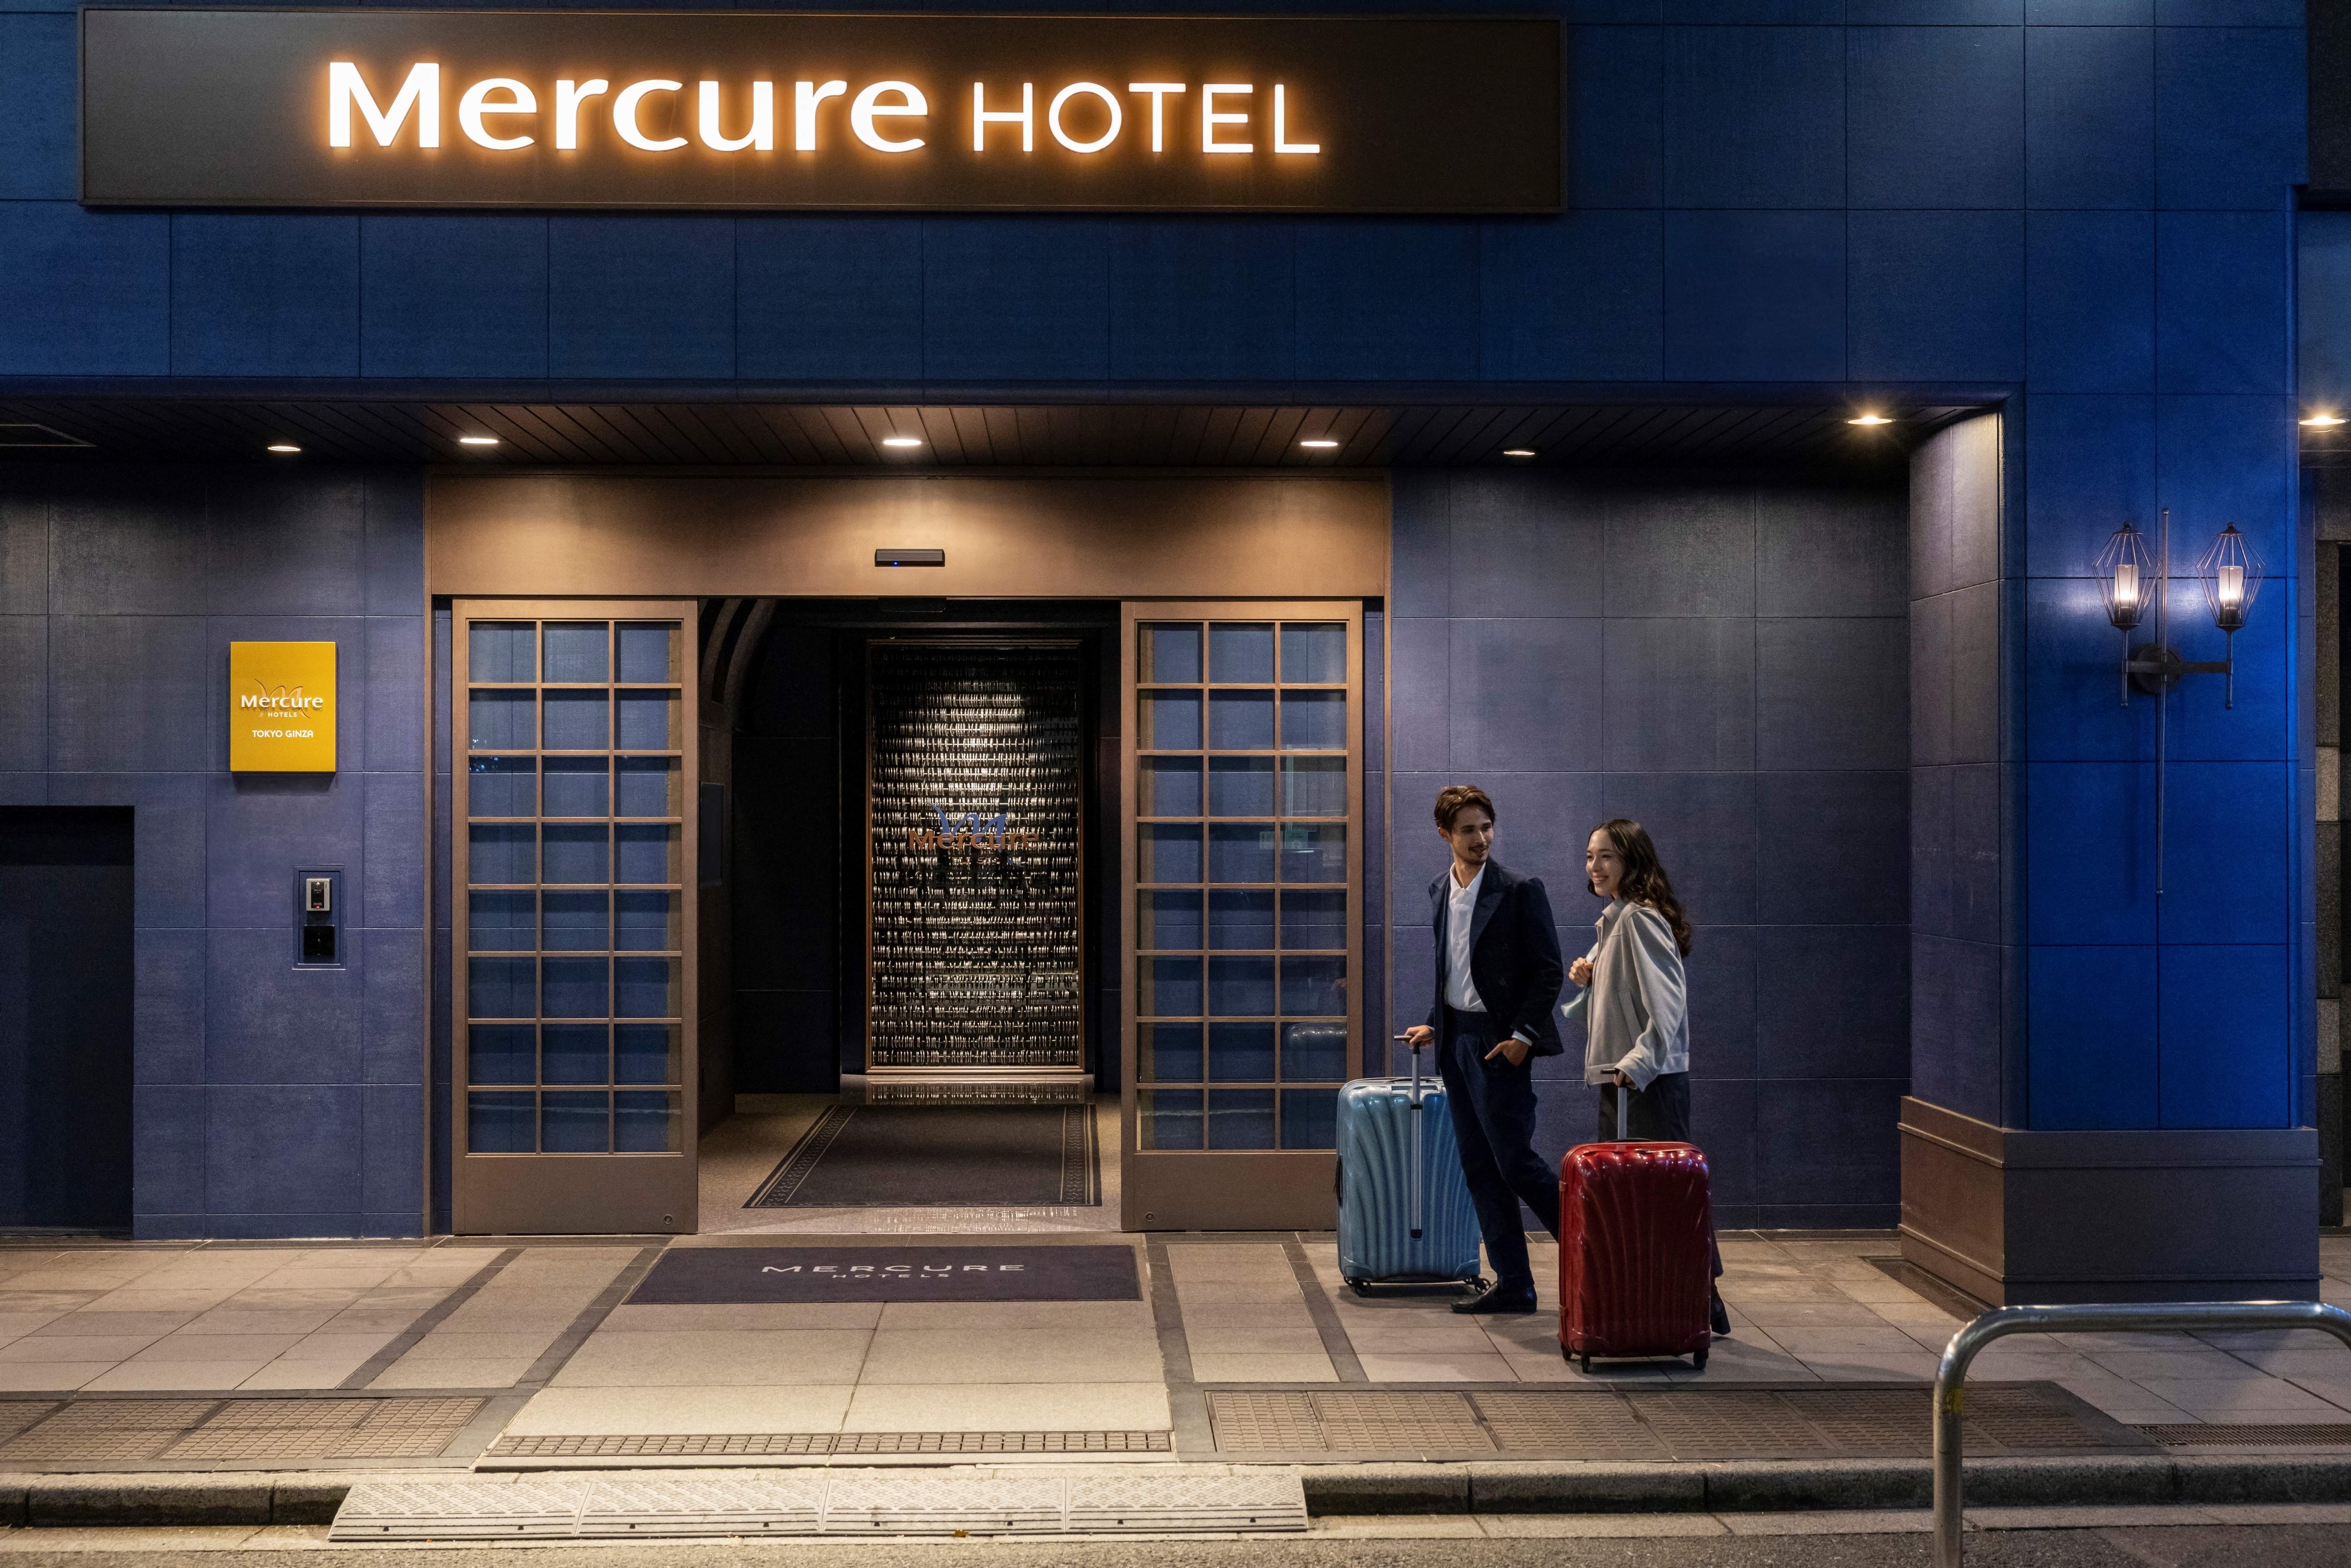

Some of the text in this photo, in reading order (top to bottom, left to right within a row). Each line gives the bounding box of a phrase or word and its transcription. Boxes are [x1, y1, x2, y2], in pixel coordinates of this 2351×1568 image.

[329, 61, 1321, 154] Mercure HOTEL
[241, 695, 323, 708] Mercure
[251, 729, 314, 738] TOKYO GINZA
[909, 830, 1039, 850] Mercure
